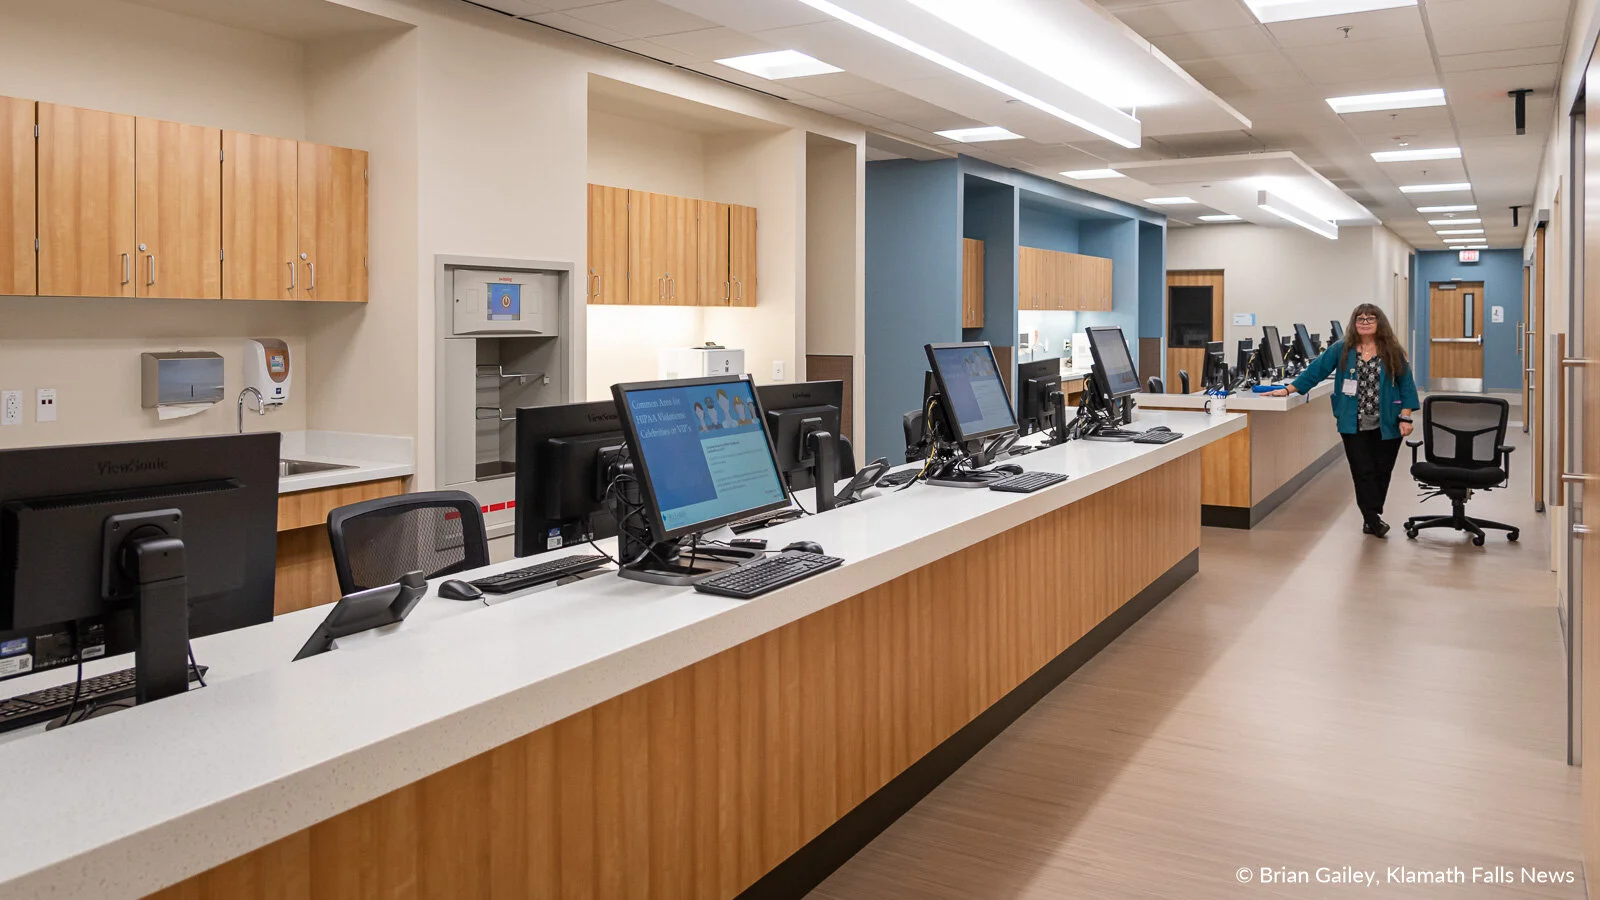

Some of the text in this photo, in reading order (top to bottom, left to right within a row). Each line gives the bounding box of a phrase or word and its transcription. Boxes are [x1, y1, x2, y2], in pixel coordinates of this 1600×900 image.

[631, 399, 658, 409] Common
[636, 414, 658, 424] HIPAA
[97, 457, 169, 475] ViewSonic
